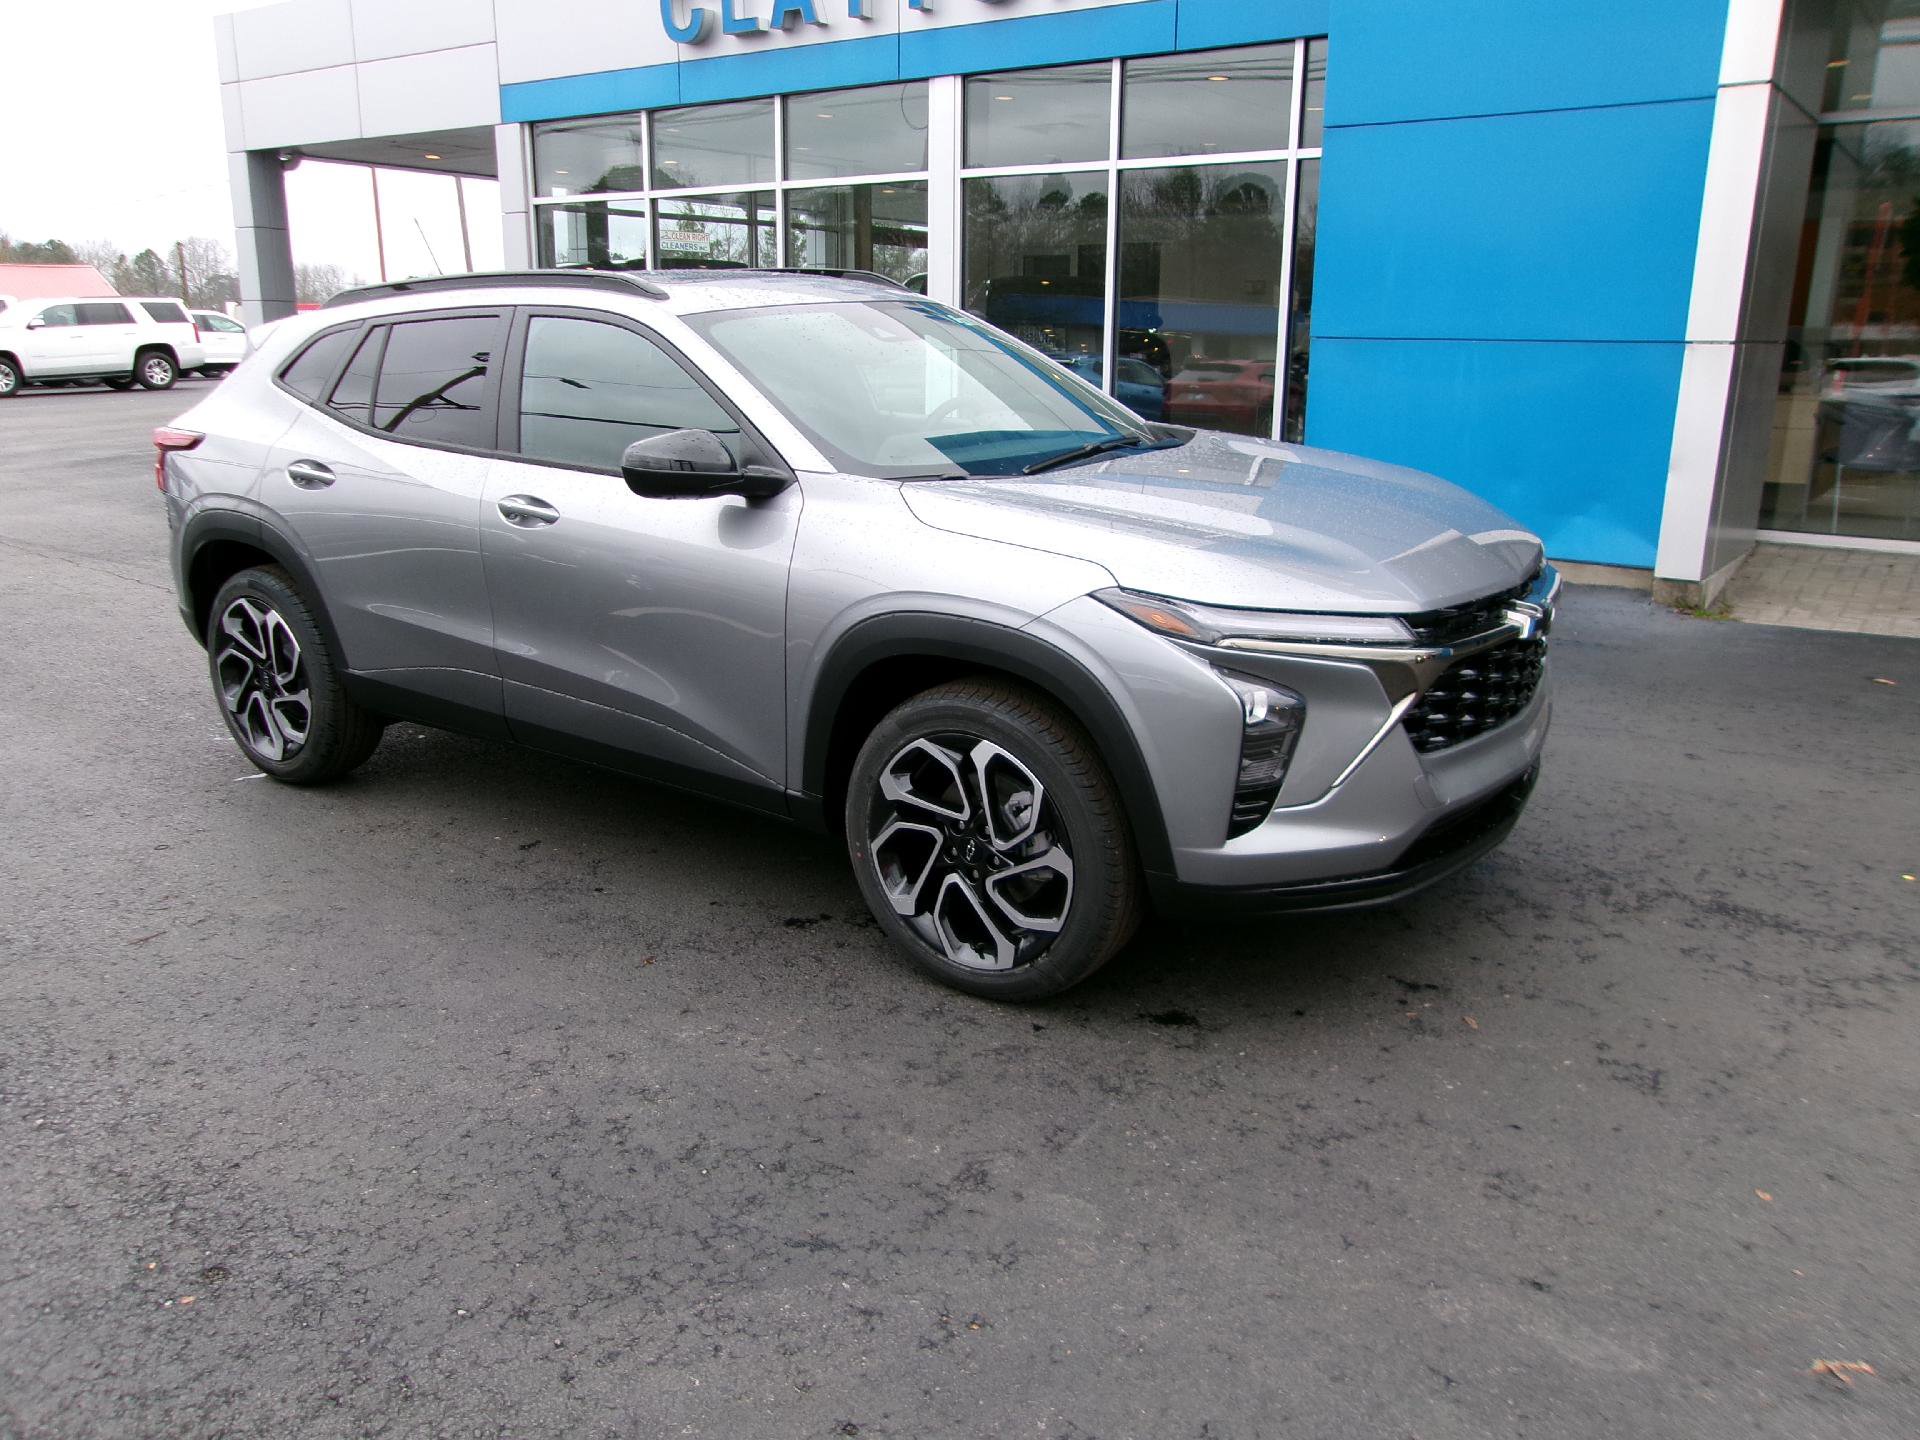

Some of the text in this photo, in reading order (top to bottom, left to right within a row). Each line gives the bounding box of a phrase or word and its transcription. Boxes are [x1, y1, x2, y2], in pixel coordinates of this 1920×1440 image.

[672, 231, 710, 242] CLEAN RIGHT
[661, 241, 698, 250] CLEANERS
